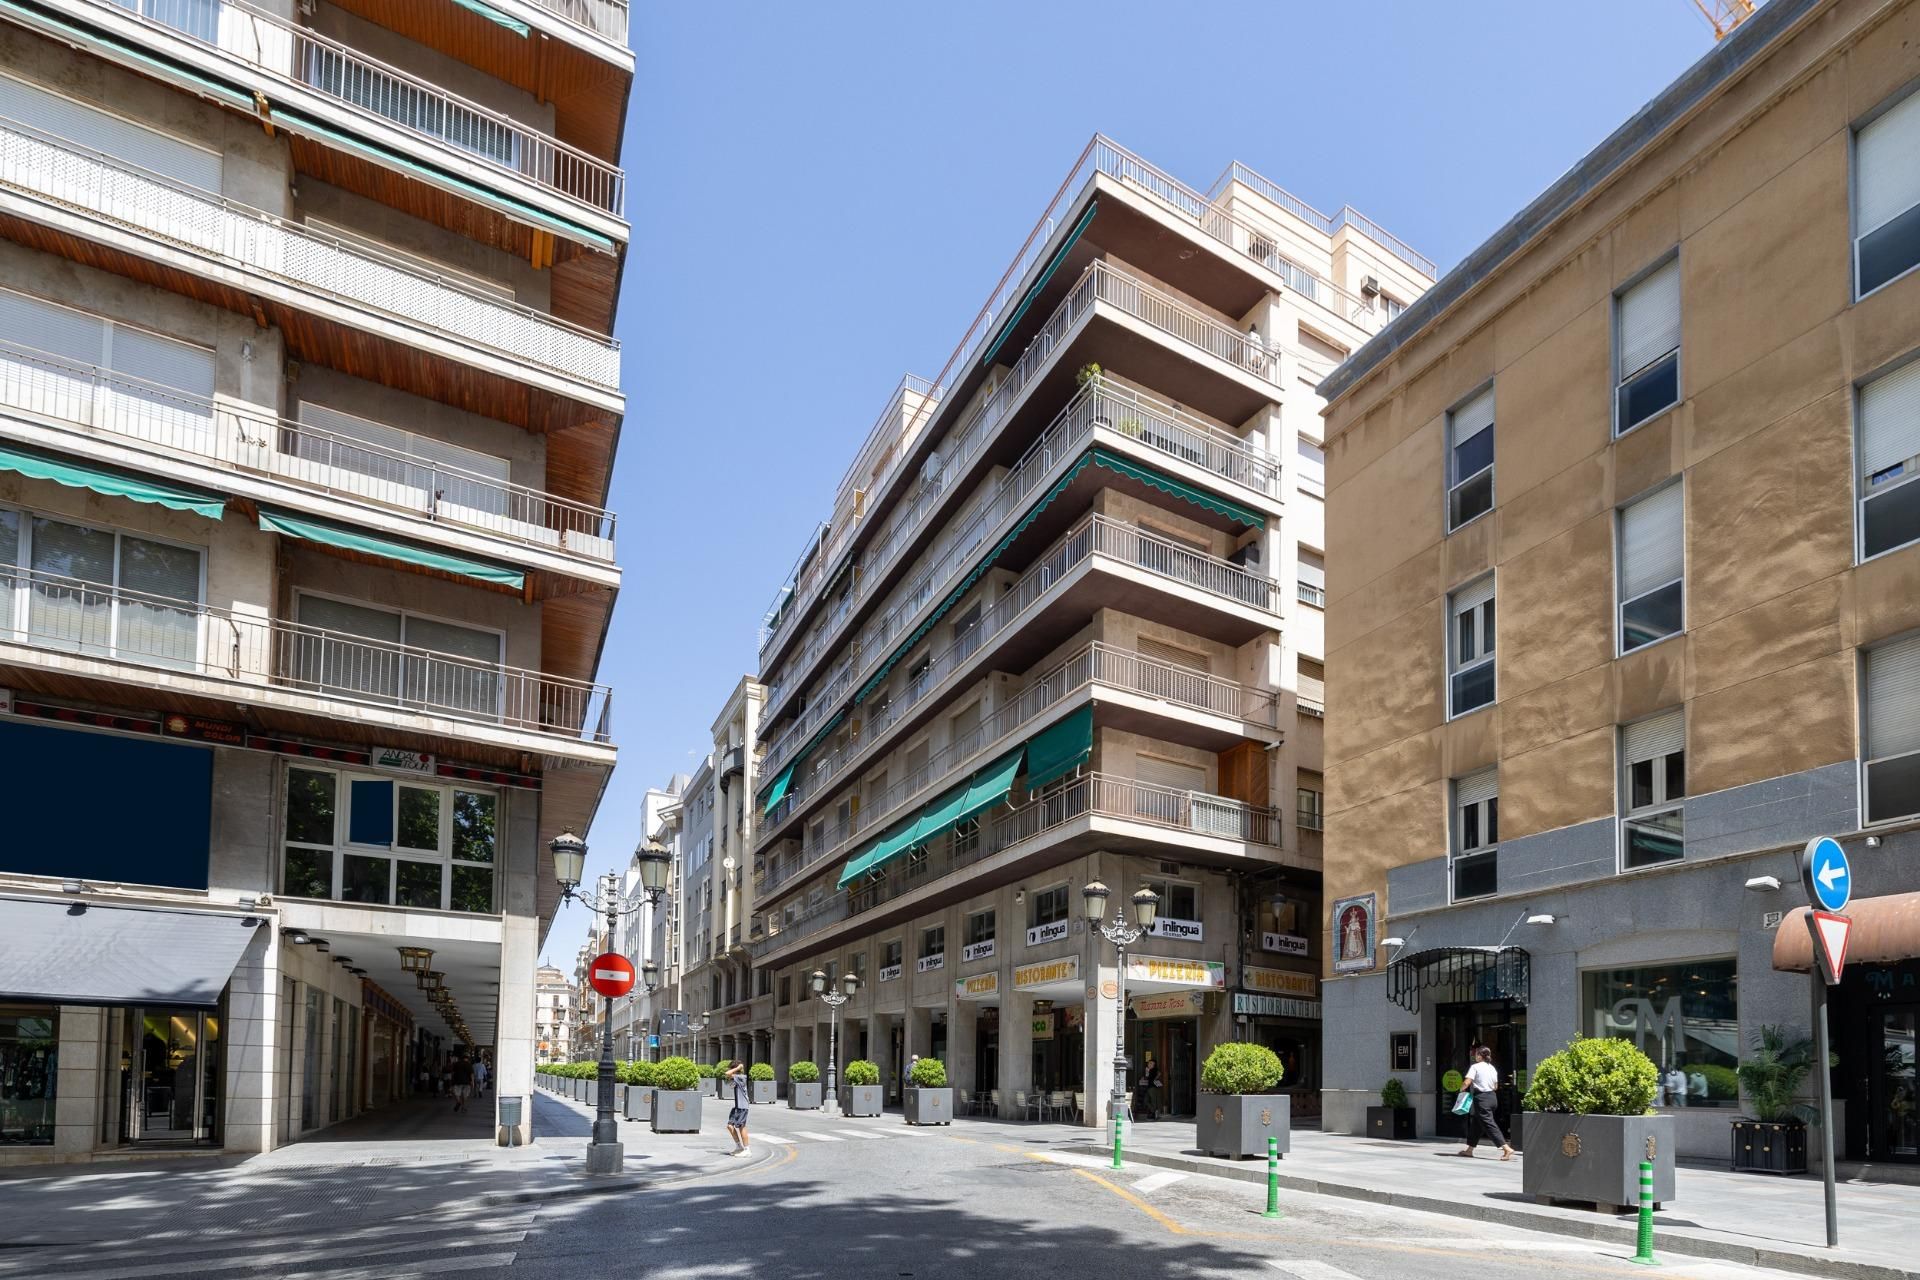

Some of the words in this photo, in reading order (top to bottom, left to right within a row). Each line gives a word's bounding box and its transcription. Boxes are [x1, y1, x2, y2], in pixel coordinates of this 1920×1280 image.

[194, 720, 232, 733] MUNDI
[204, 731, 241, 742] COLOR
[402, 760, 430, 772] TOUR
[1040, 924, 1066, 938] inlingua
[1162, 920, 1199, 937] inlingua
[973, 943, 993, 956] inlingua
[1278, 936, 1306, 951] inlingua
[926, 956, 942, 968] inlingua
[1015, 962, 1068, 985] RISTORANTE
[1255, 971, 1314, 992] RISTORANTE
[1398, 1045, 1409, 1055] EM
